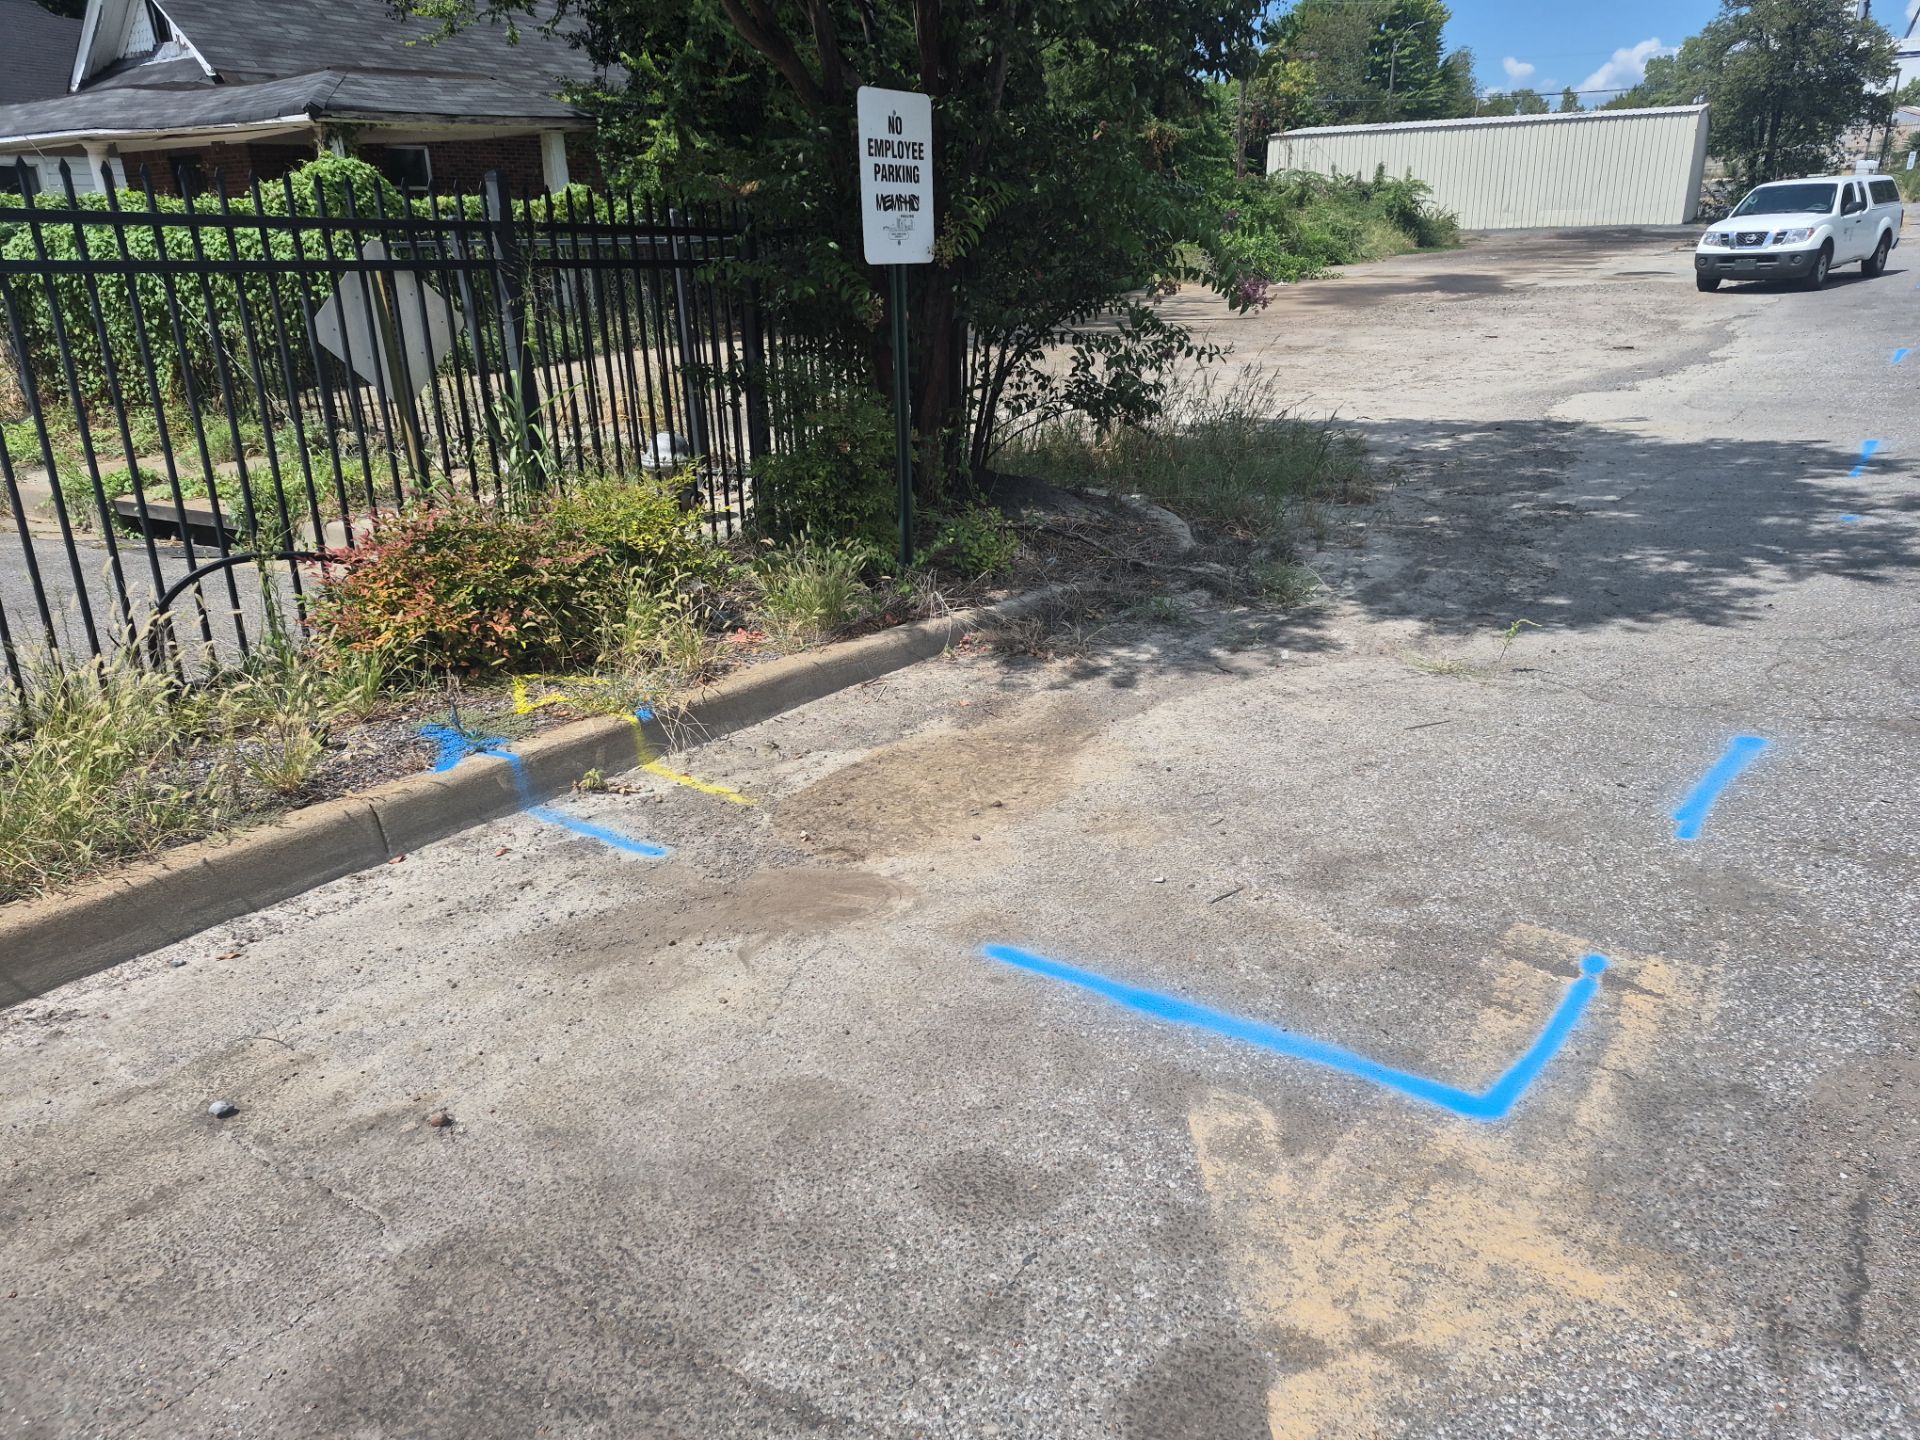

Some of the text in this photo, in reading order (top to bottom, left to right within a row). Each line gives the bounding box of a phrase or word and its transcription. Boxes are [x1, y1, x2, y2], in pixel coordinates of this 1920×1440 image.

[888, 116, 902, 135] NO
[867, 138, 924, 161] EMPLOYEE
[874, 163, 920, 184] PARKING
